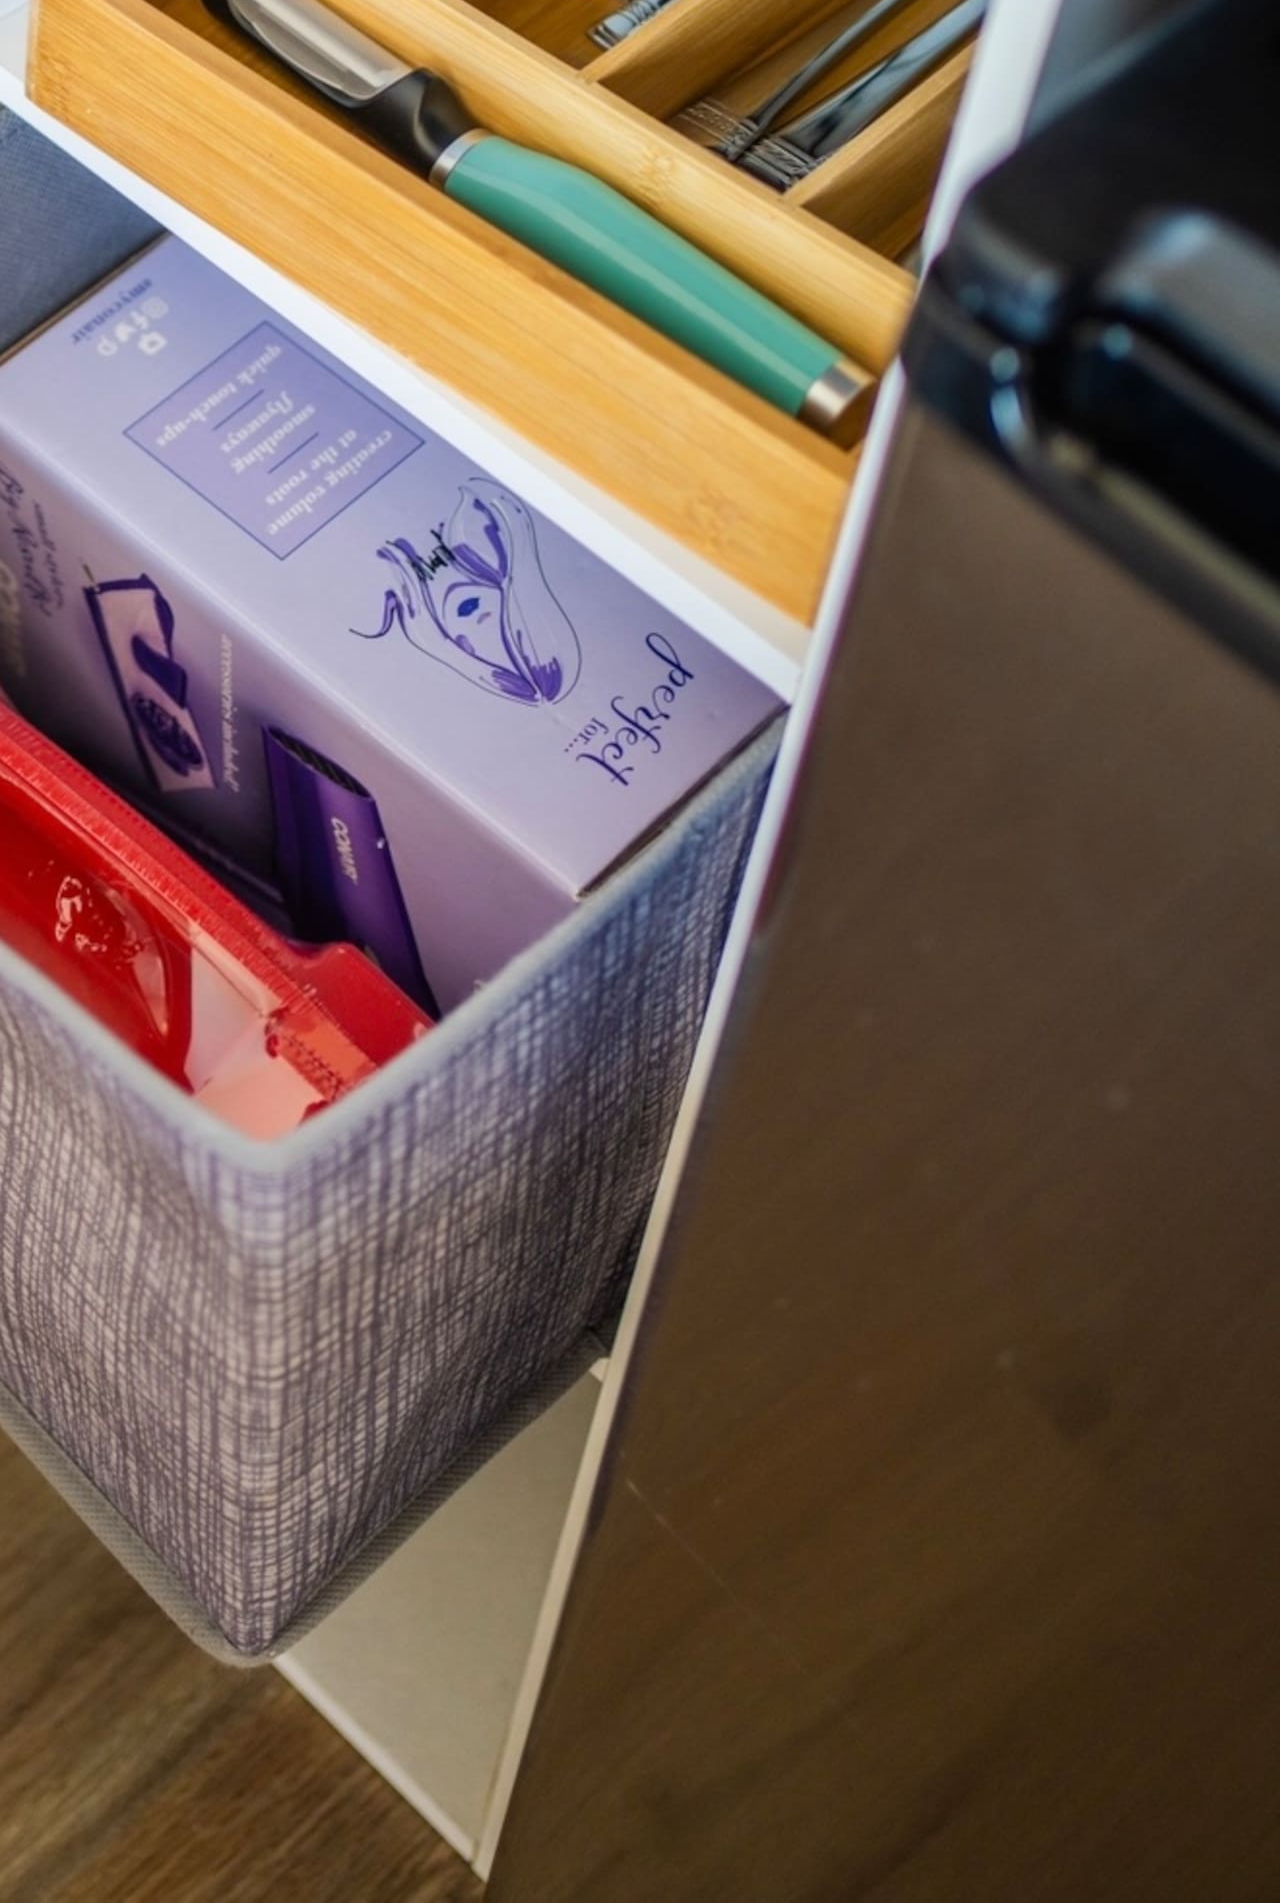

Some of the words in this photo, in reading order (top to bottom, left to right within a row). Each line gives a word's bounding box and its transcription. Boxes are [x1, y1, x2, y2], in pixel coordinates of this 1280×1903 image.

[237, 344, 283, 387] quick
[156, 380, 238, 448] touch-ups
[221, 391, 294, 454] flyaways
[231, 403, 316, 475] smoothing
[338, 428, 358, 448] at
[310, 445, 339, 472] the
[324, 430, 393, 487] creating
[266, 470, 309, 506] roots
[269, 483, 328, 536] volume
[564, 717, 610, 753] for...
[576, 632, 695, 787] perfect
